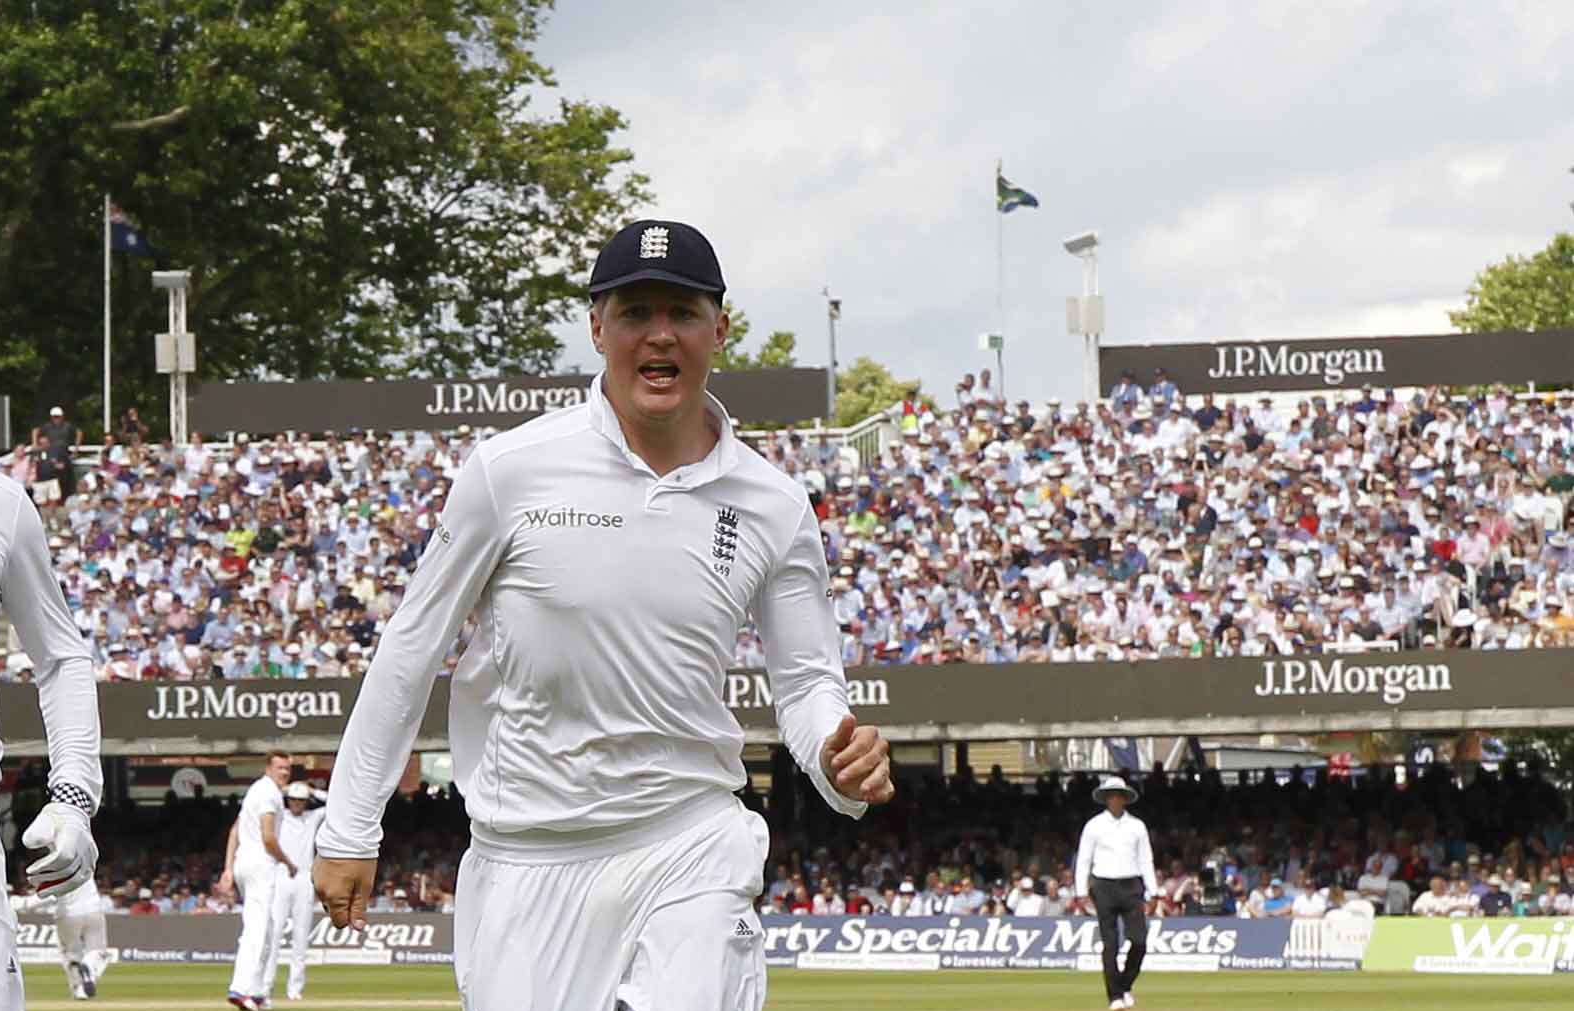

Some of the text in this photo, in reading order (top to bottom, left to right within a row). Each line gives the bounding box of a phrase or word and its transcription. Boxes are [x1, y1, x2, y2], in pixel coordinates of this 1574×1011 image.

[1209, 345, 1385, 383] J.P.Morgan
[426, 383, 590, 416] J.P.Morga
[525, 506, 623, 528] Waitrose
[1255, 659, 1453, 704] J.P.Morgan
[147, 686, 343, 728] J.P.Morgan
[835, 917, 1043, 956] Specialty
[1043, 917, 1237, 954] Mkets
